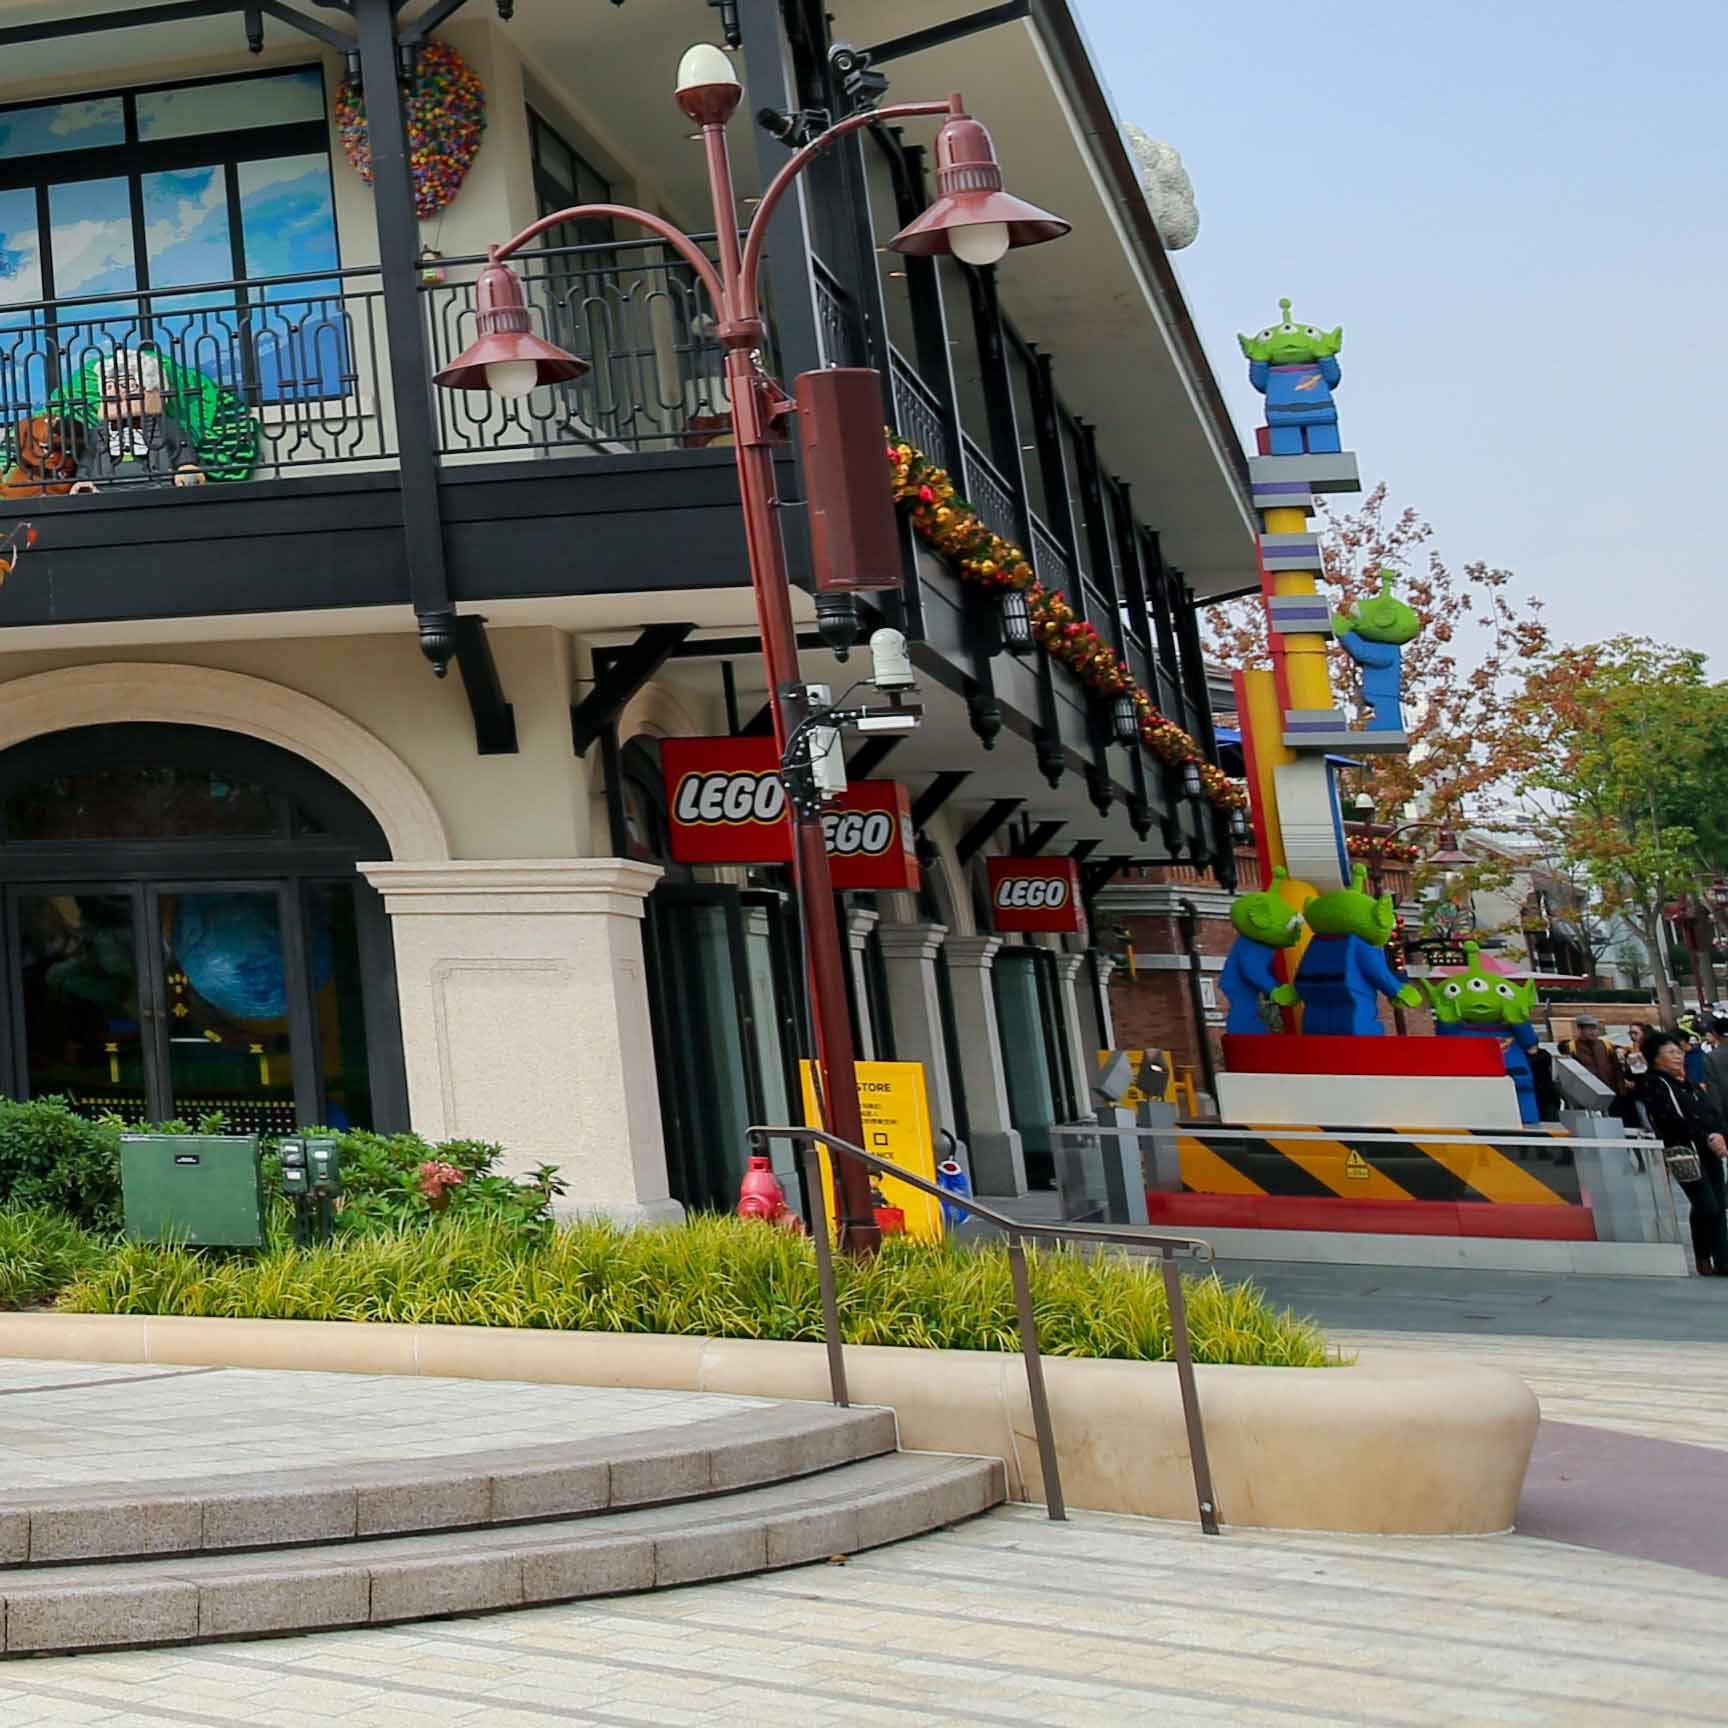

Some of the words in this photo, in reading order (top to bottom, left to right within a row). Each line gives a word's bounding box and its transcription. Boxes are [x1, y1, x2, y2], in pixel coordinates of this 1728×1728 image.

[677, 775, 785, 820] LEGO
[822, 814, 891, 852] EGO
[997, 879, 1066, 907] LEGO
